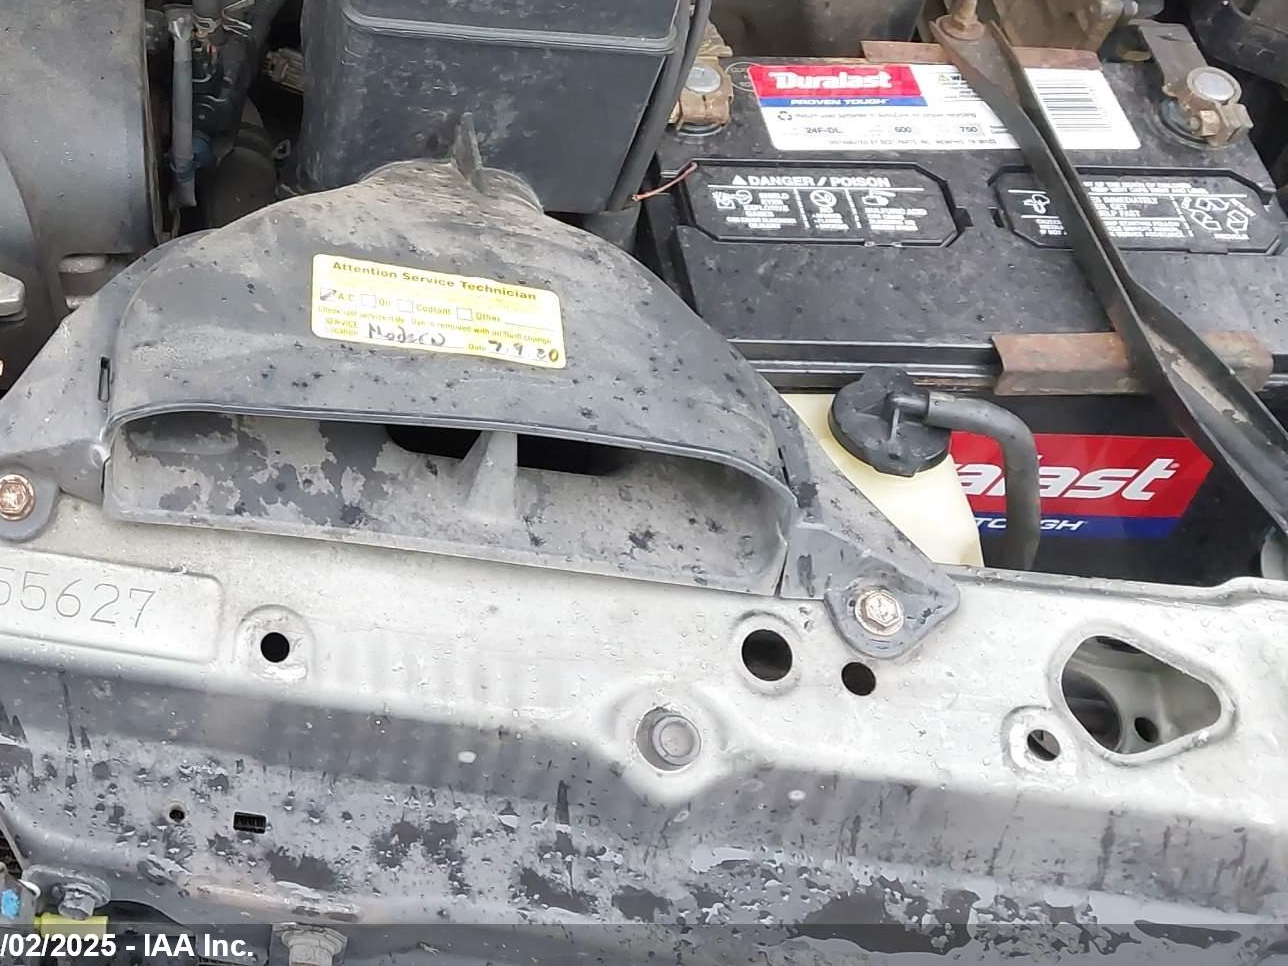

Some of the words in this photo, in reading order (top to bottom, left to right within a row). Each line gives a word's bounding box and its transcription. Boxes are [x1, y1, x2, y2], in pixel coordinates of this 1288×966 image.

[768, 71, 892, 90] Duralast
[790, 98, 841, 106] PROVEN
[844, 98, 887, 106] TOUGH
[747, 175, 815, 187] DANGER
[816, 176, 827, 187] /
[829, 177, 892, 188] POISON
[333, 261, 398, 279] Attention
[402, 271, 454, 287] Service
[460, 280, 537, 301] Technician
[416, 303, 451, 316] Coolant
[475, 312, 502, 323] Other
[474, 327, 490, 335] with
